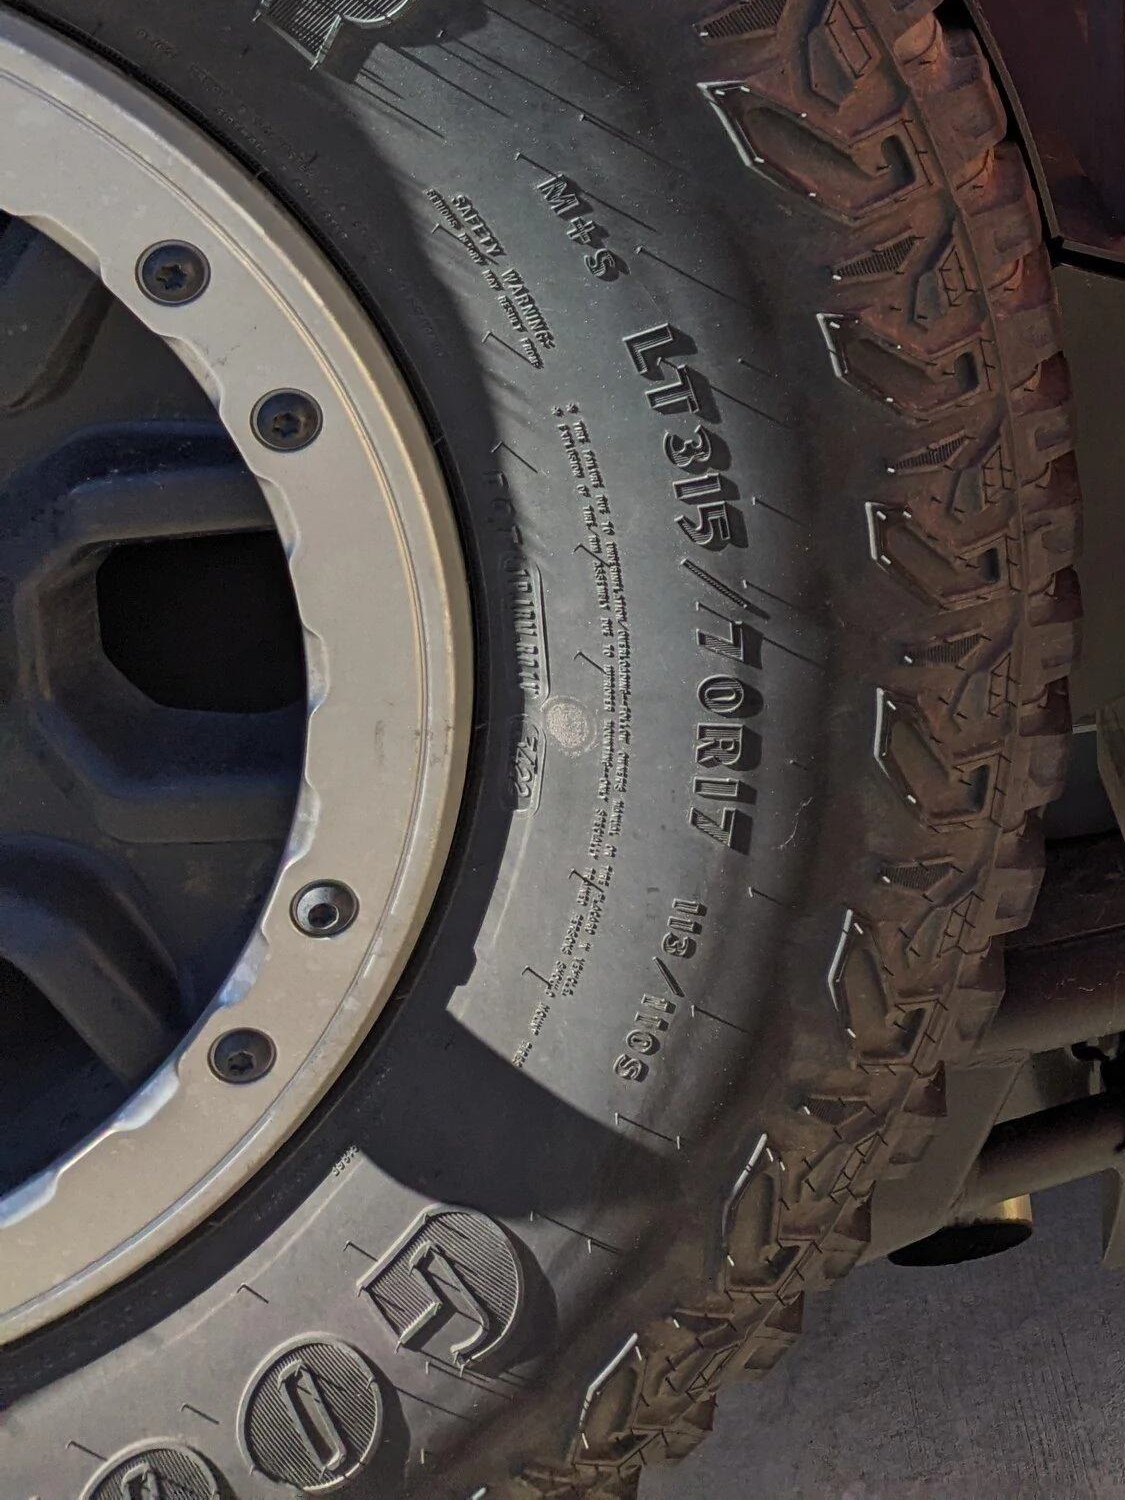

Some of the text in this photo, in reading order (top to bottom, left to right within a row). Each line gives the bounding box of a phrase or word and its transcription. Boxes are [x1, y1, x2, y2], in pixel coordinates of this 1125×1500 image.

[423, 185, 464, 233] SERIOUS
[480, 267, 503, 294] MAY
[496, 293, 526, 335] RESULT
[450, 192, 506, 262] SAFETY
[622, 323, 748, 850] LT315/70R17
